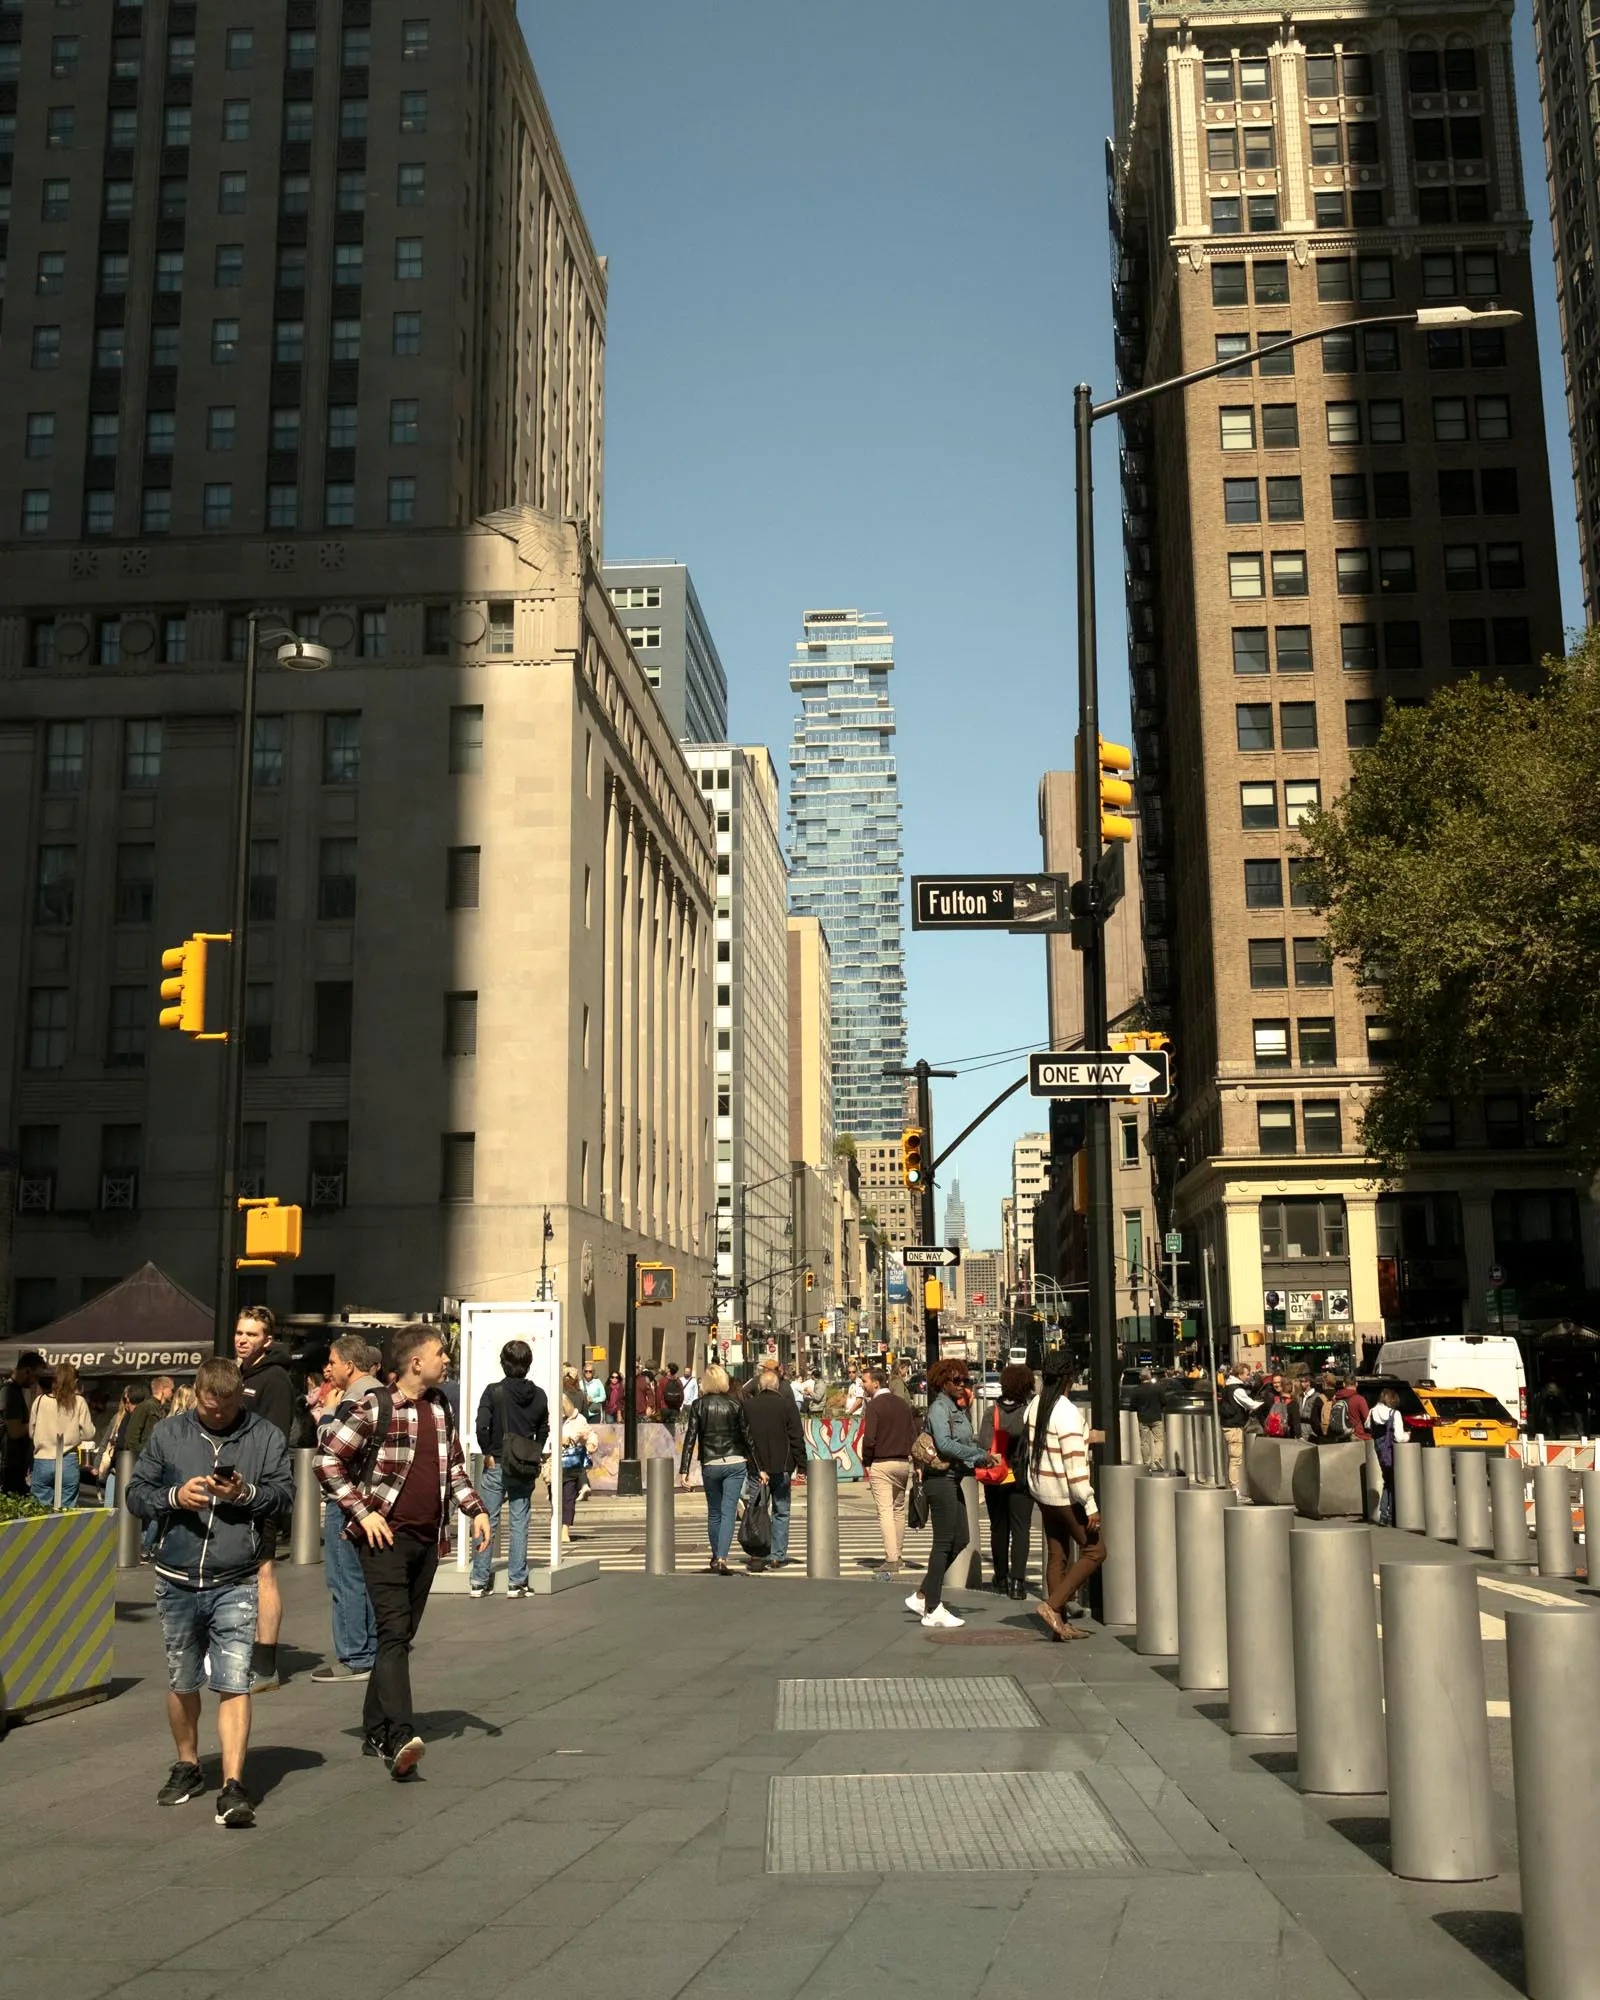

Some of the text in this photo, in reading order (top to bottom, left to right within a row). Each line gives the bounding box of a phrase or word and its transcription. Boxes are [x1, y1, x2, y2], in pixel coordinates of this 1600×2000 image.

[929, 889, 1003, 915] Fulton St
[1043, 1066, 1124, 1083] ONE WAY
[908, 1252, 941, 1261] ONE WAY
[1291, 1305, 1303, 1313] GI
[38, 1346, 202, 1369] Burger Supreme
